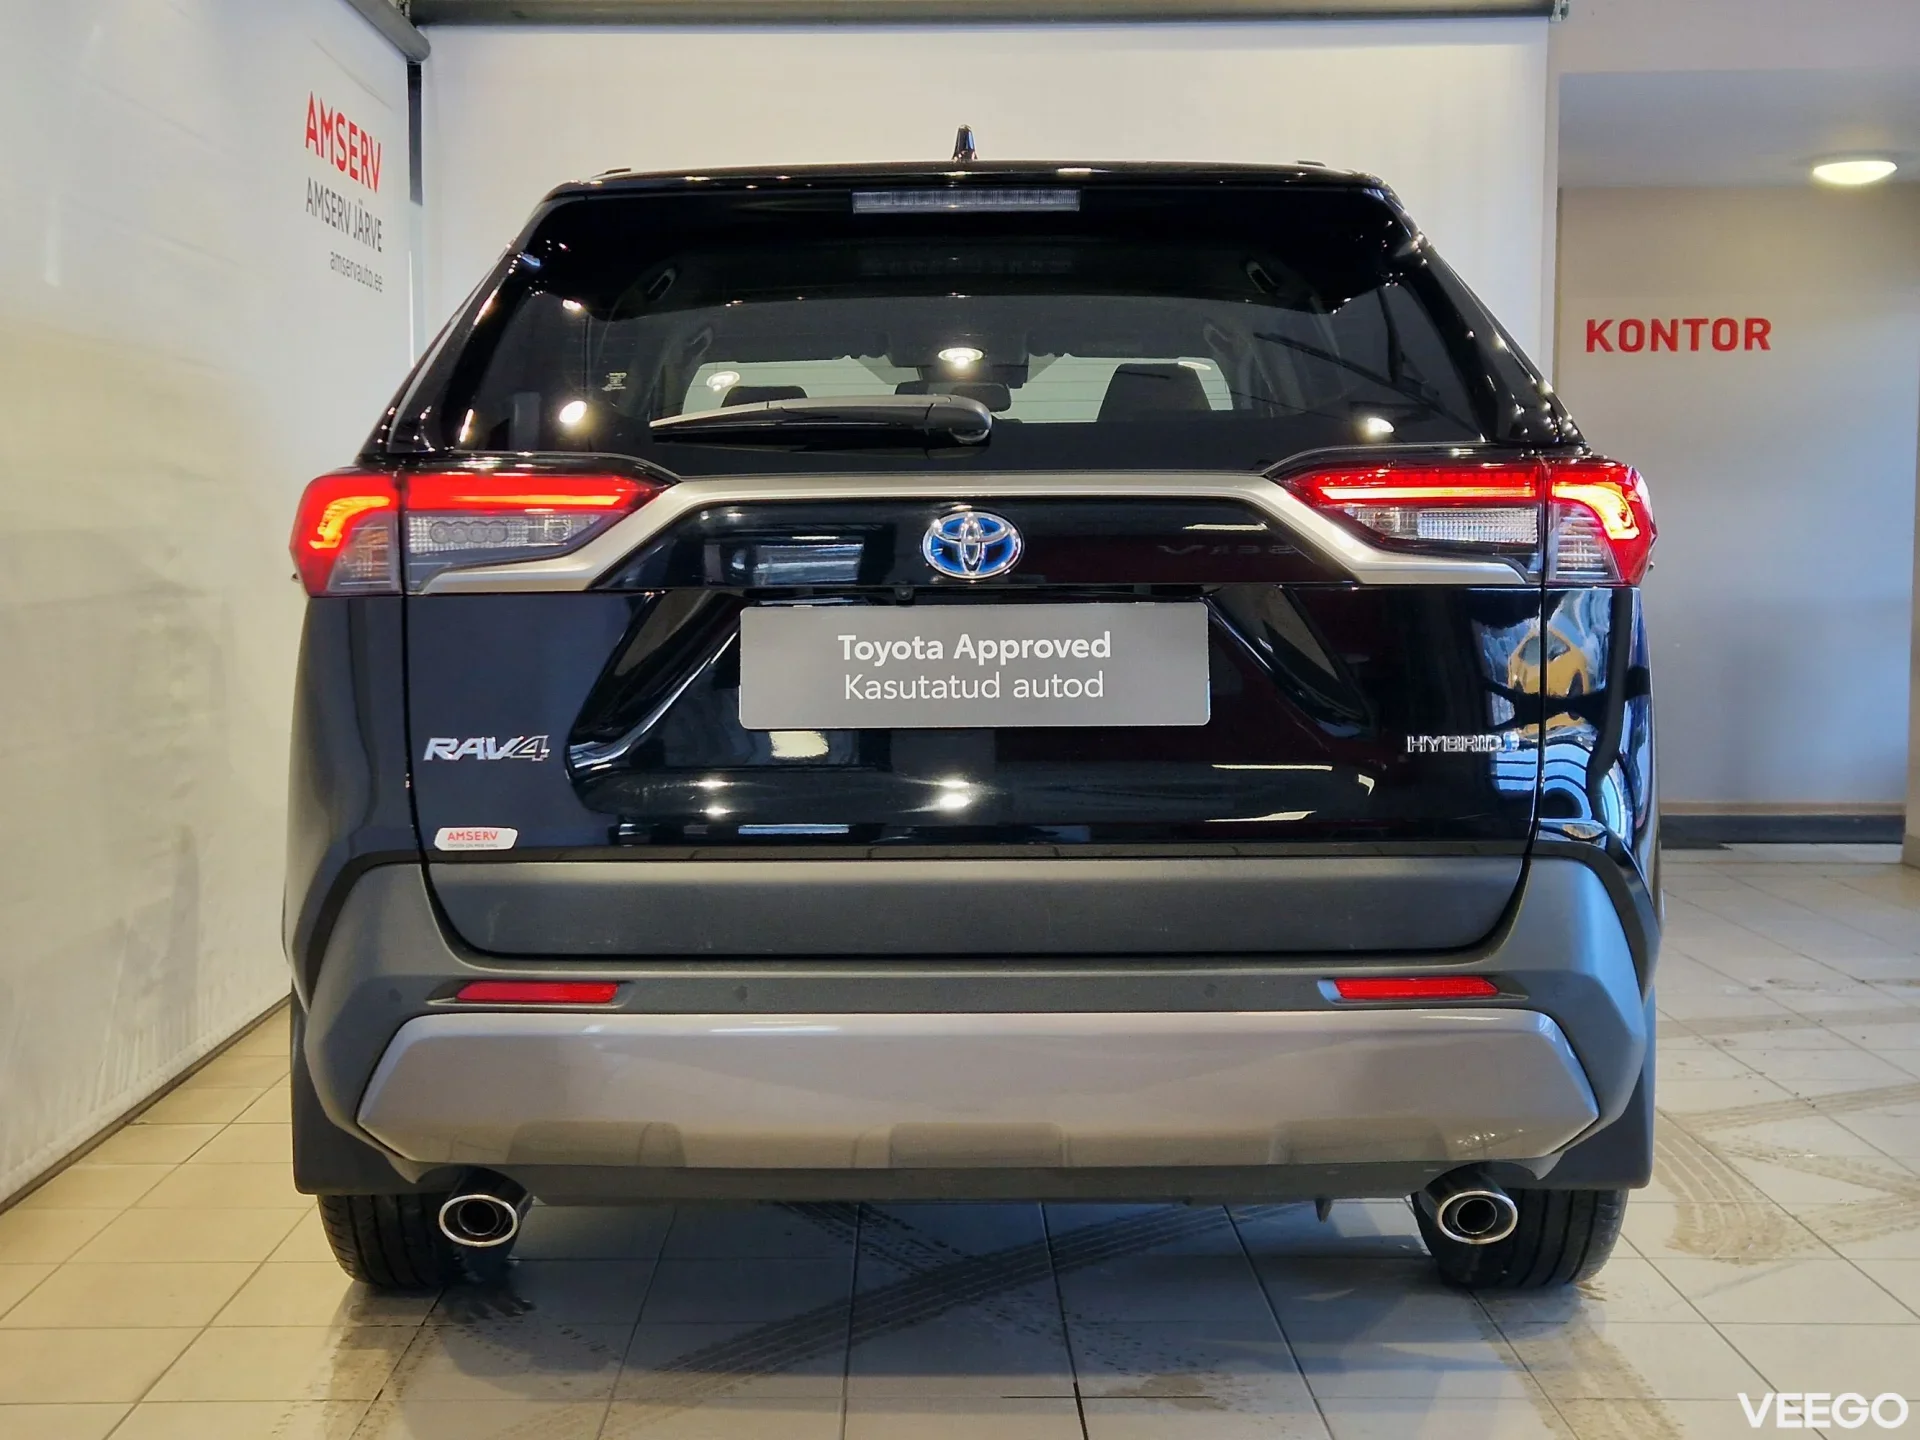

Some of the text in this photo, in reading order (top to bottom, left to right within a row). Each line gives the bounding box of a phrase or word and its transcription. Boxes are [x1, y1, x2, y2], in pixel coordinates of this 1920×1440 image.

[305, 90, 382, 193] AMSERV
[306, 177, 382, 252] AMSERV JÄRVE
[329, 251, 383, 293] amservauto.ee
[1585, 317, 1772, 352] KONTOR
[838, 631, 1112, 666] Toyota Approved
[844, 670, 1105, 700] Kasutatud autod
[423, 734, 550, 762] RAV4
[1406, 734, 1502, 753] HYBRID
[447, 831, 499, 841] AMSERV
